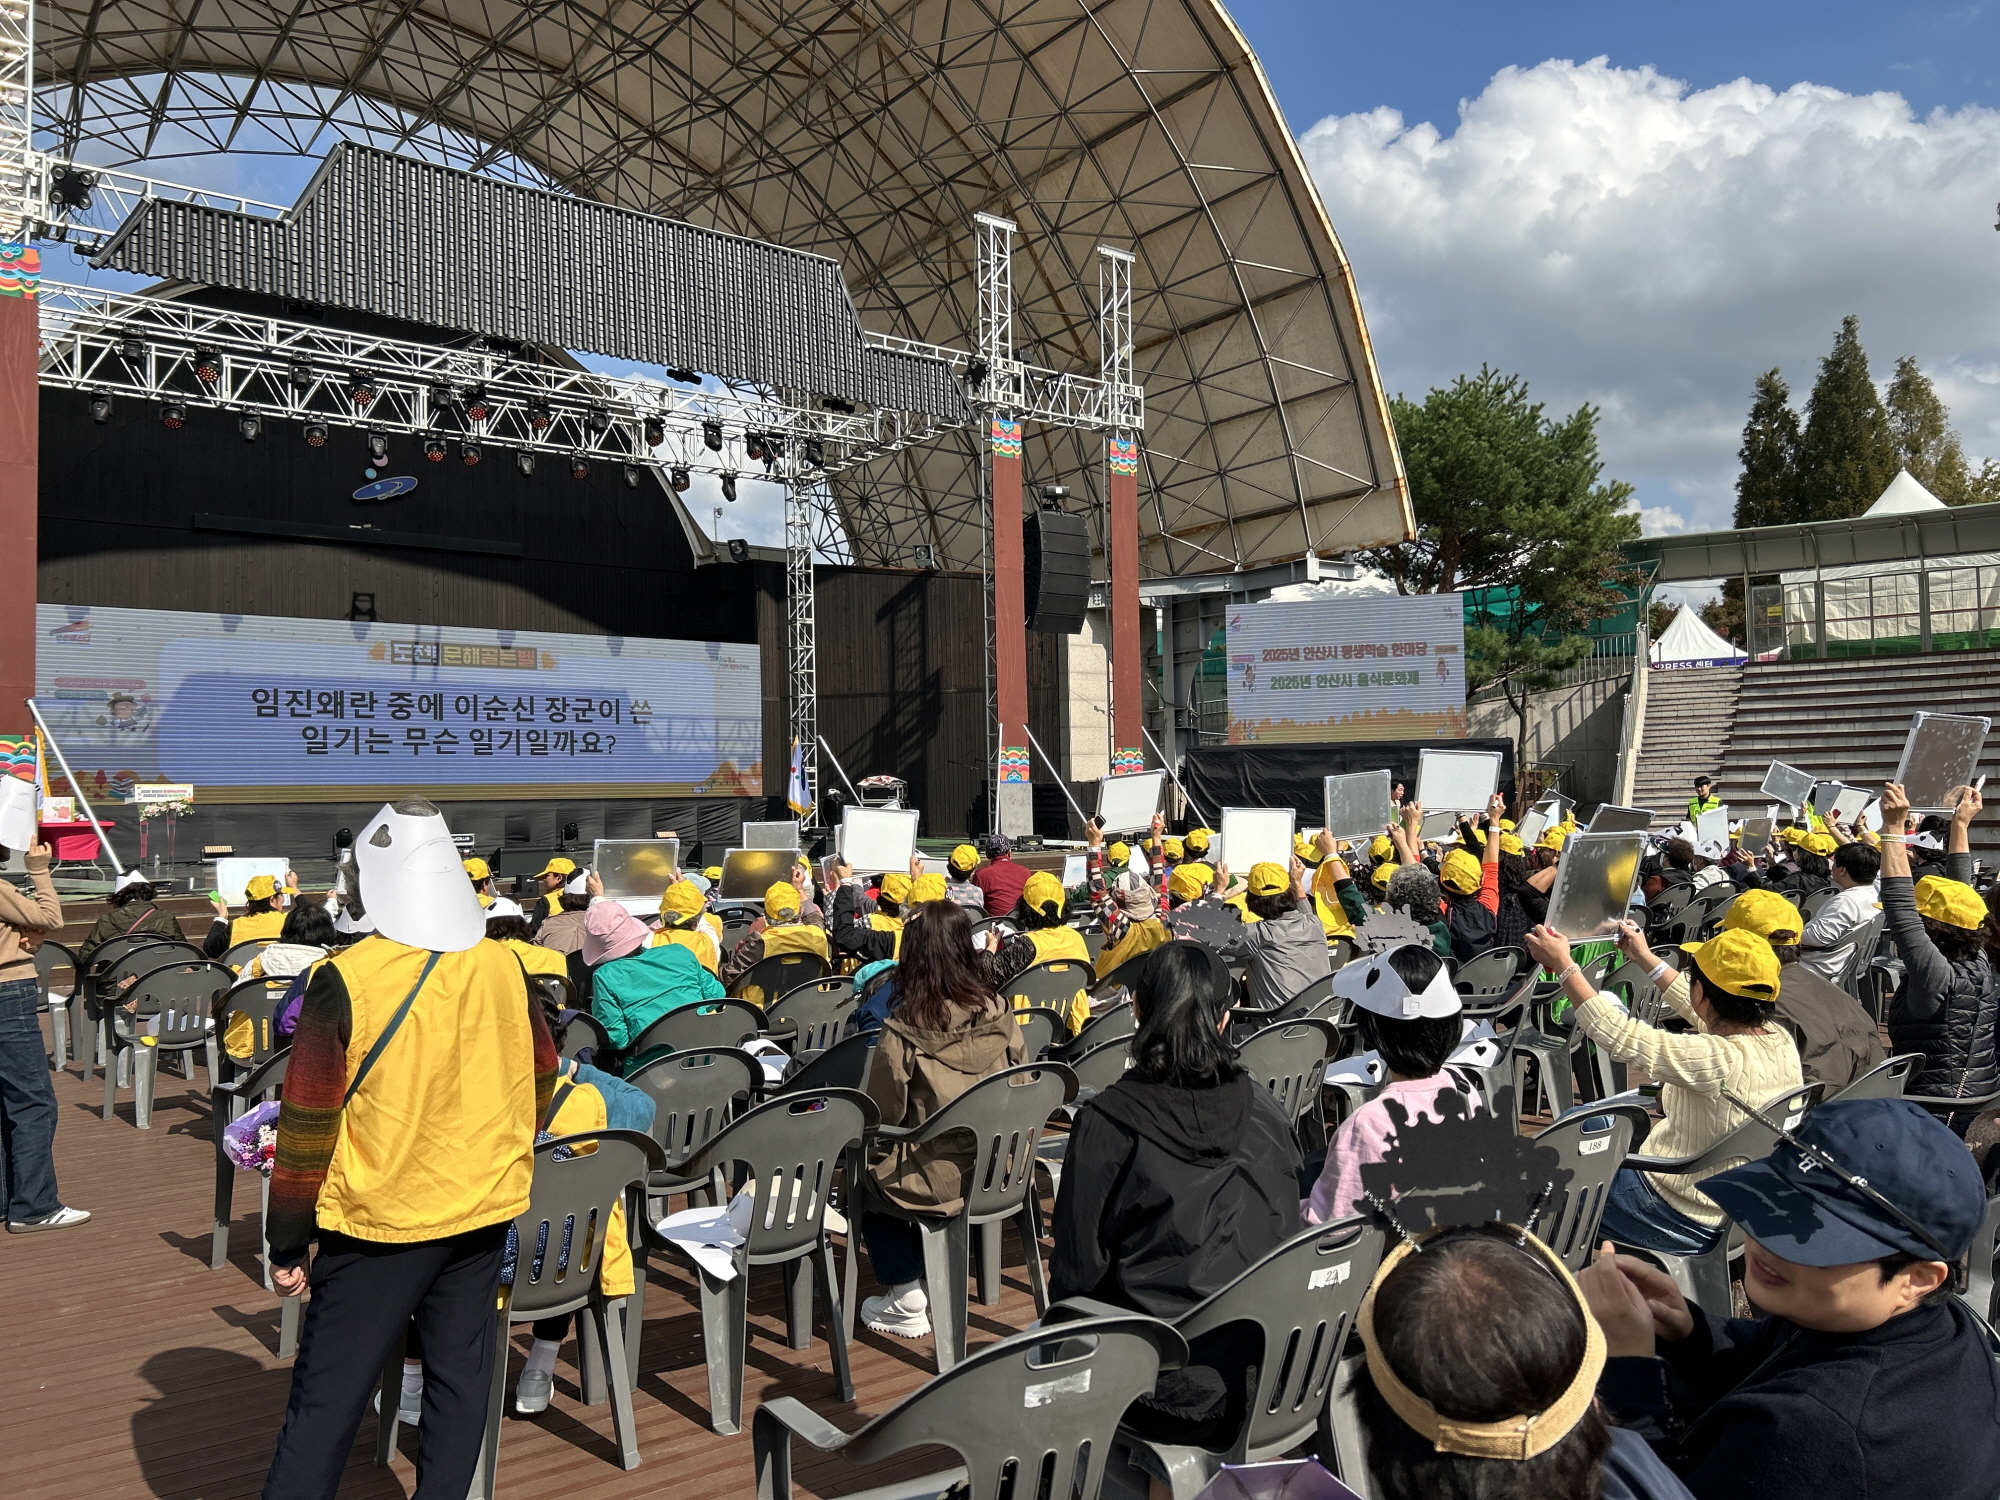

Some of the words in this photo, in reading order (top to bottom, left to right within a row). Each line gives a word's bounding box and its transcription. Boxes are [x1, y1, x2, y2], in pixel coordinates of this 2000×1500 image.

[393, 643, 437, 664] 도전!
[443, 646, 535, 668] 문해골든벨
[1262, 647, 1300, 662] 2025년
[1303, 646, 1338, 660] 안산시
[1341, 643, 1388, 659] 평생학습
[1391, 642, 1428, 657] 한마당
[1316, 673, 1352, 689] 안산시
[1357, 670, 1419, 687] 음식문화제
[251, 688, 378, 719] 임진왜란
[387, 692, 444, 721] 중에
[454, 694, 535, 722] 이순신
[545, 696, 620, 724] 장군이
[629, 699, 653, 724] 쓴
[301, 725, 393, 755] 일기는
[402, 728, 459, 755] 무슨
[469, 728, 616, 756] 일기일까요?
[1588, 1140, 1602, 1152] 188
